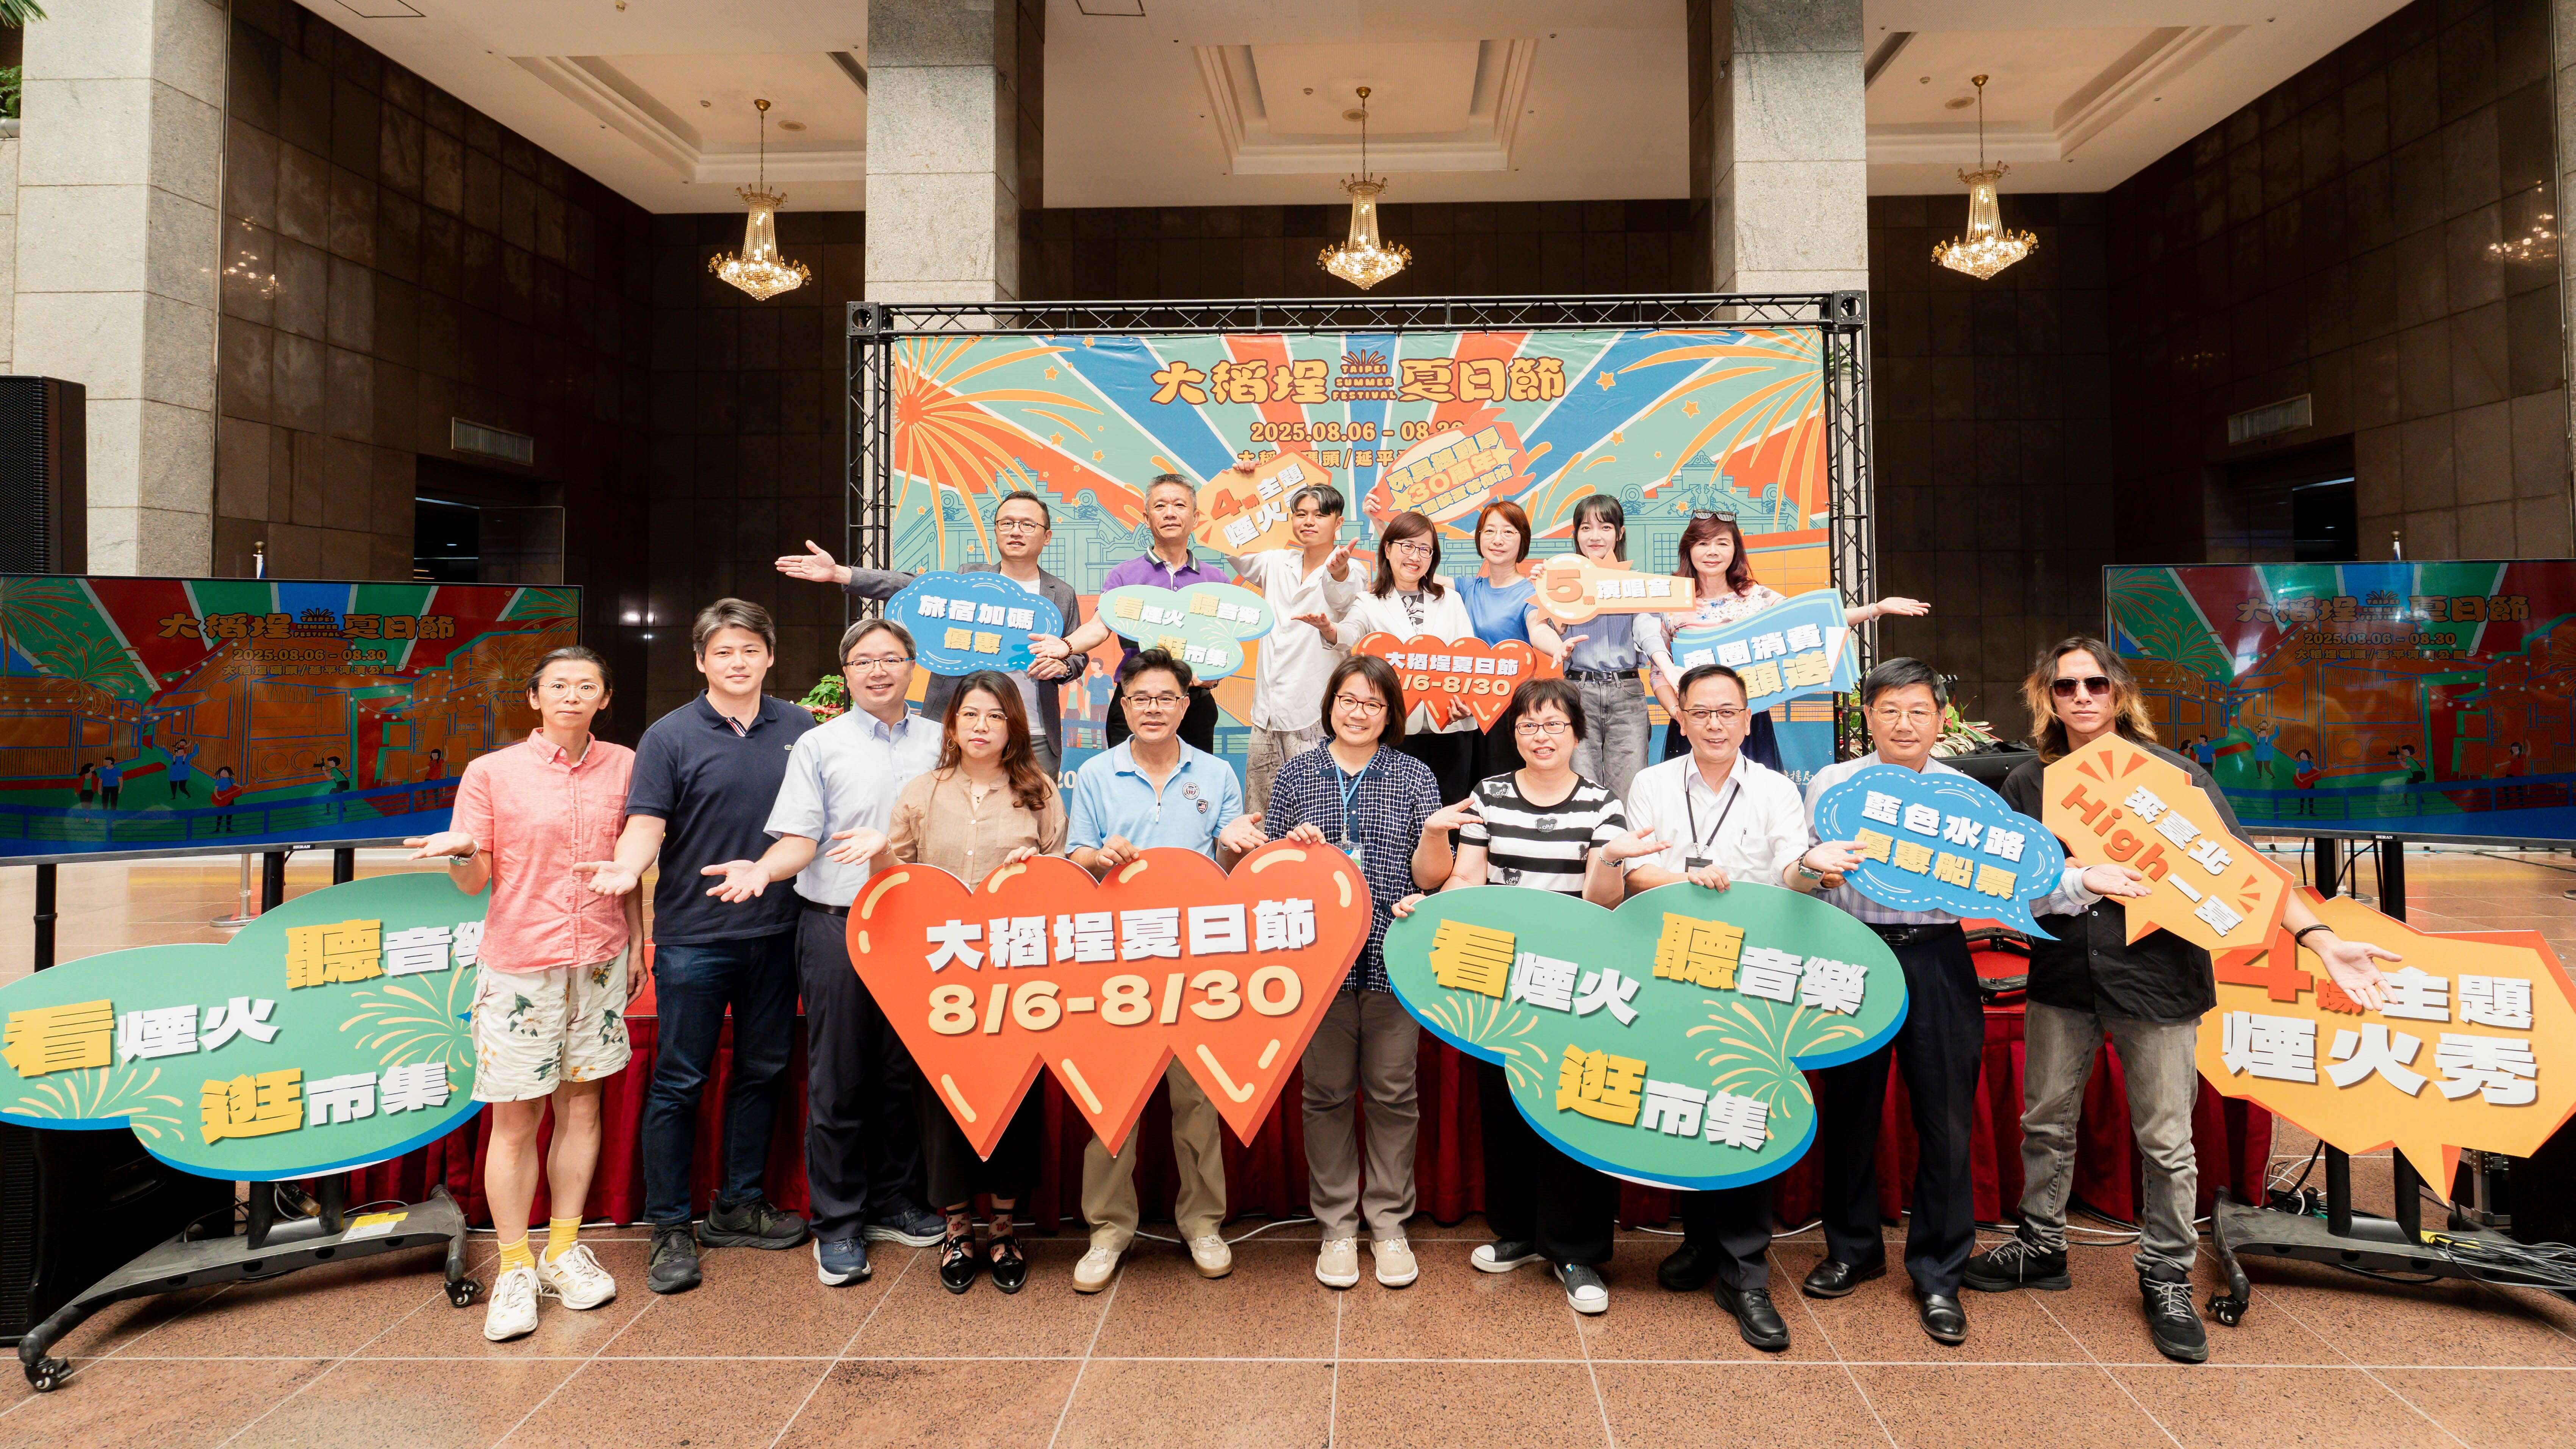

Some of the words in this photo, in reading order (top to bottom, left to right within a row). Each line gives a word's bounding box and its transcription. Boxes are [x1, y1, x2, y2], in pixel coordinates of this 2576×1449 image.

[1150, 359, 1329, 405] 大稻埕
[1335, 377, 1395, 387] SUMMER
[1340, 364, 1388, 374] TAIPEI
[1398, 357, 1566, 403] 夏日節
[1331, 390, 1397, 402] FESTIVAL
[1250, 421, 1377, 442] 2025.08.06
[1385, 425, 1500, 491] 玩具總動員
[1408, 449, 1498, 504] 30周年
[1222, 484, 1308, 549] 煙火
[157, 612, 292, 639] 大稻埕
[343, 614, 455, 640] 夏日節
[918, 595, 1035, 631] 旅宿加碼
[1114, 595, 1185, 628] 看煙火
[1189, 592, 1261, 625] 聽音樂
[2236, 596, 2359, 623] 大稻埕
[2408, 595, 2530, 623] 夏日節
[233, 649, 325, 661] 2025.08.06
[342, 649, 387, 661] 08.30
[944, 627, 1002, 655] 優惠
[1683, 623, 1824, 670] 商圈消費
[2303, 632, 2392, 645] 2025.08.06
[2409, 632, 2457, 645] 08.30
[1385, 652, 1518, 676] 大稻埕夏日節
[1397, 674, 1511, 696] /6-8/30
[1861, 790, 2025, 862] 藍色水路
[2124, 785, 2232, 875] 來臺北
[1853, 827, 2017, 900] 優惠船票
[926, 898, 1318, 972] 大稻埕夏日節
[1428, 918, 1640, 1025] 看煙火
[1653, 911, 1868, 1016] 聽音樂
[928, 964, 1302, 1035] 8/6-8/30
[1, 995, 280, 1077] 看煙火
[2221, 1011, 2537, 1105] 煙火秀
[199, 1062, 450, 1145] 逛市集
[1555, 1044, 1769, 1150] 逛市集
